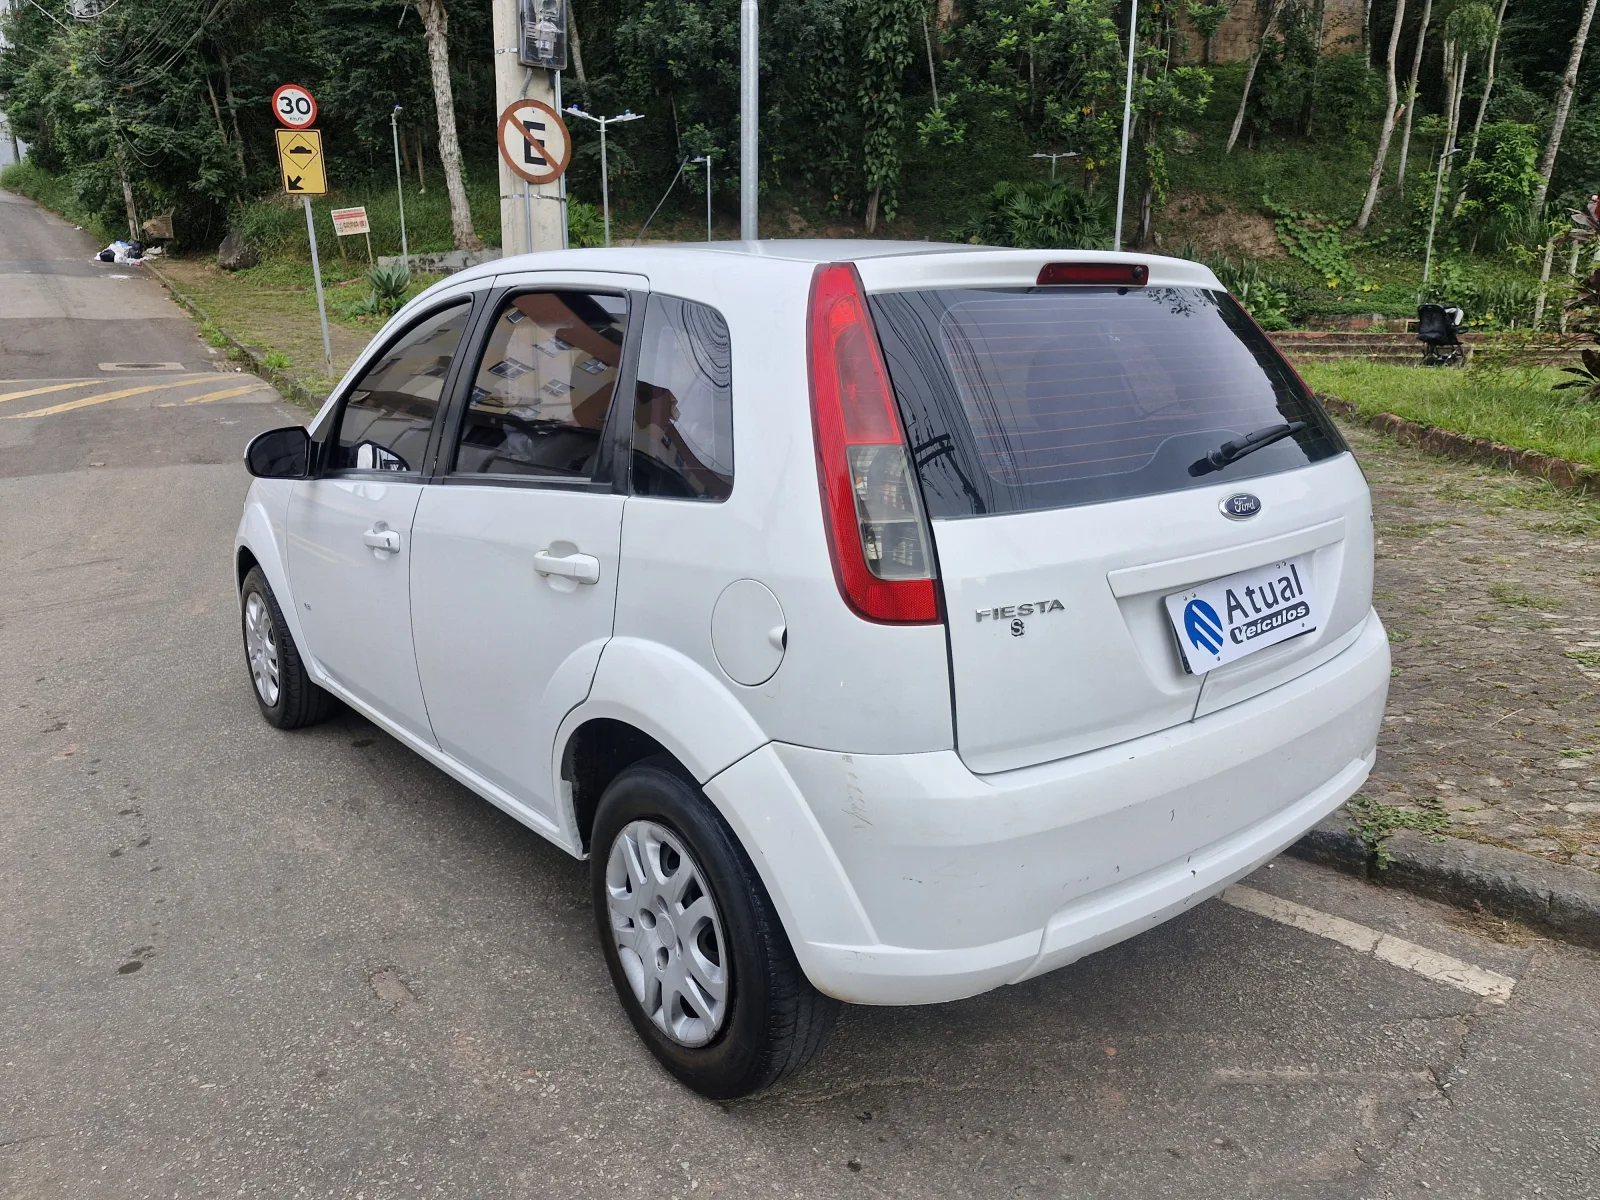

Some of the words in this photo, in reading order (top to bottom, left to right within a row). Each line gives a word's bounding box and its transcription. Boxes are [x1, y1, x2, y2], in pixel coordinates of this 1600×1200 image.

[279, 96, 311, 115] 30
[523, 120, 547, 166] E
[1233, 496, 1256, 513] Ford
[975, 598, 1066, 622] FIESTA
[1225, 563, 1304, 625] Atual
[1232, 603, 1307, 643] Veículos
